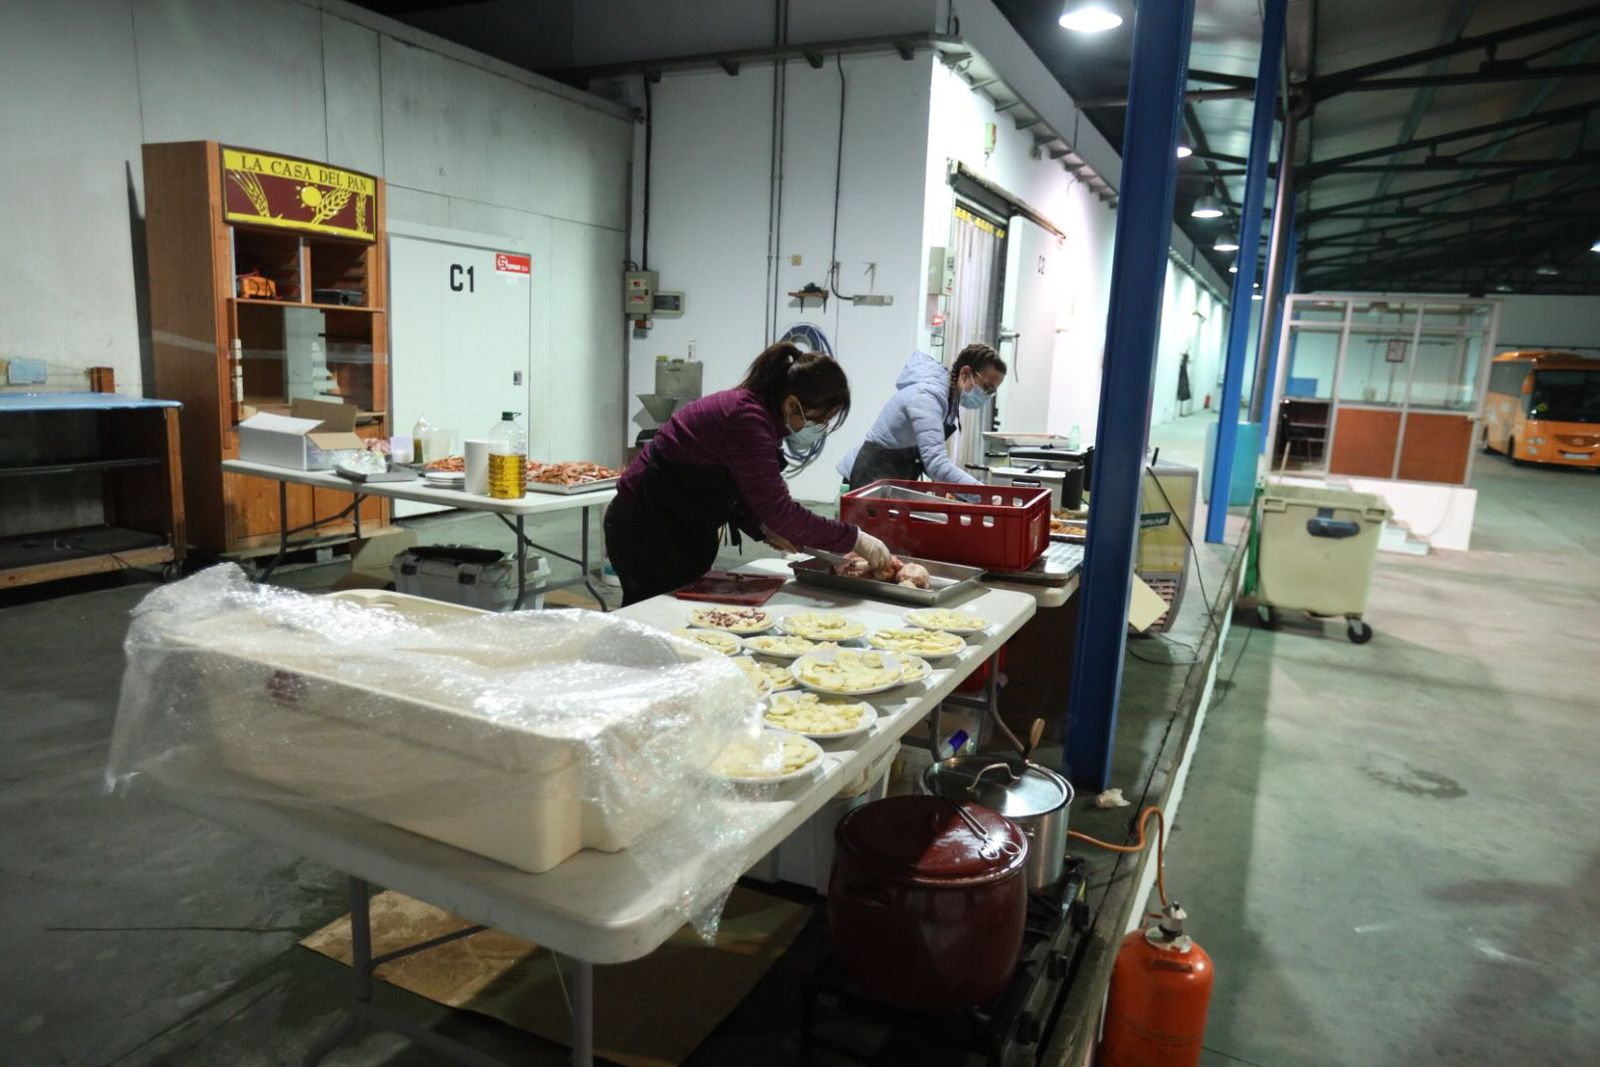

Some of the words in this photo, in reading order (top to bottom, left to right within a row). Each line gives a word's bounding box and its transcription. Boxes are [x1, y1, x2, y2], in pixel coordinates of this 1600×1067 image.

[240, 155, 263, 172] LA
[270, 160, 312, 181] CASA
[319, 169, 343, 187] DEL
[347, 177, 367, 192] PAN
[450, 264, 474, 293] C1
